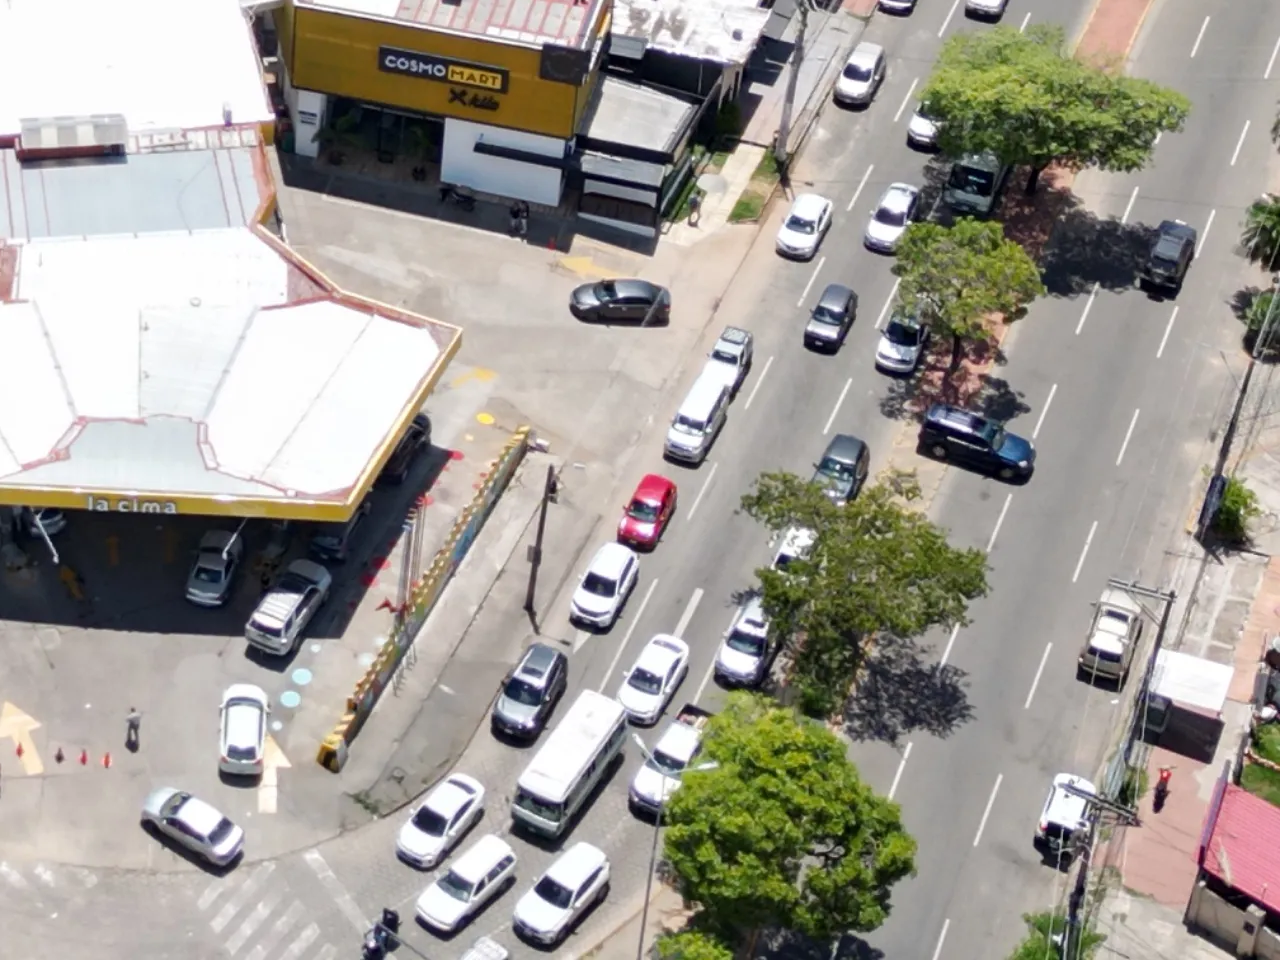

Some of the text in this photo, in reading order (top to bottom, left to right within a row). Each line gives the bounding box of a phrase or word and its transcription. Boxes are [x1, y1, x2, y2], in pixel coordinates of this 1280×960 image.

[384, 55, 500, 87] COSMO MART
[87, 495, 177, 514] la cima
